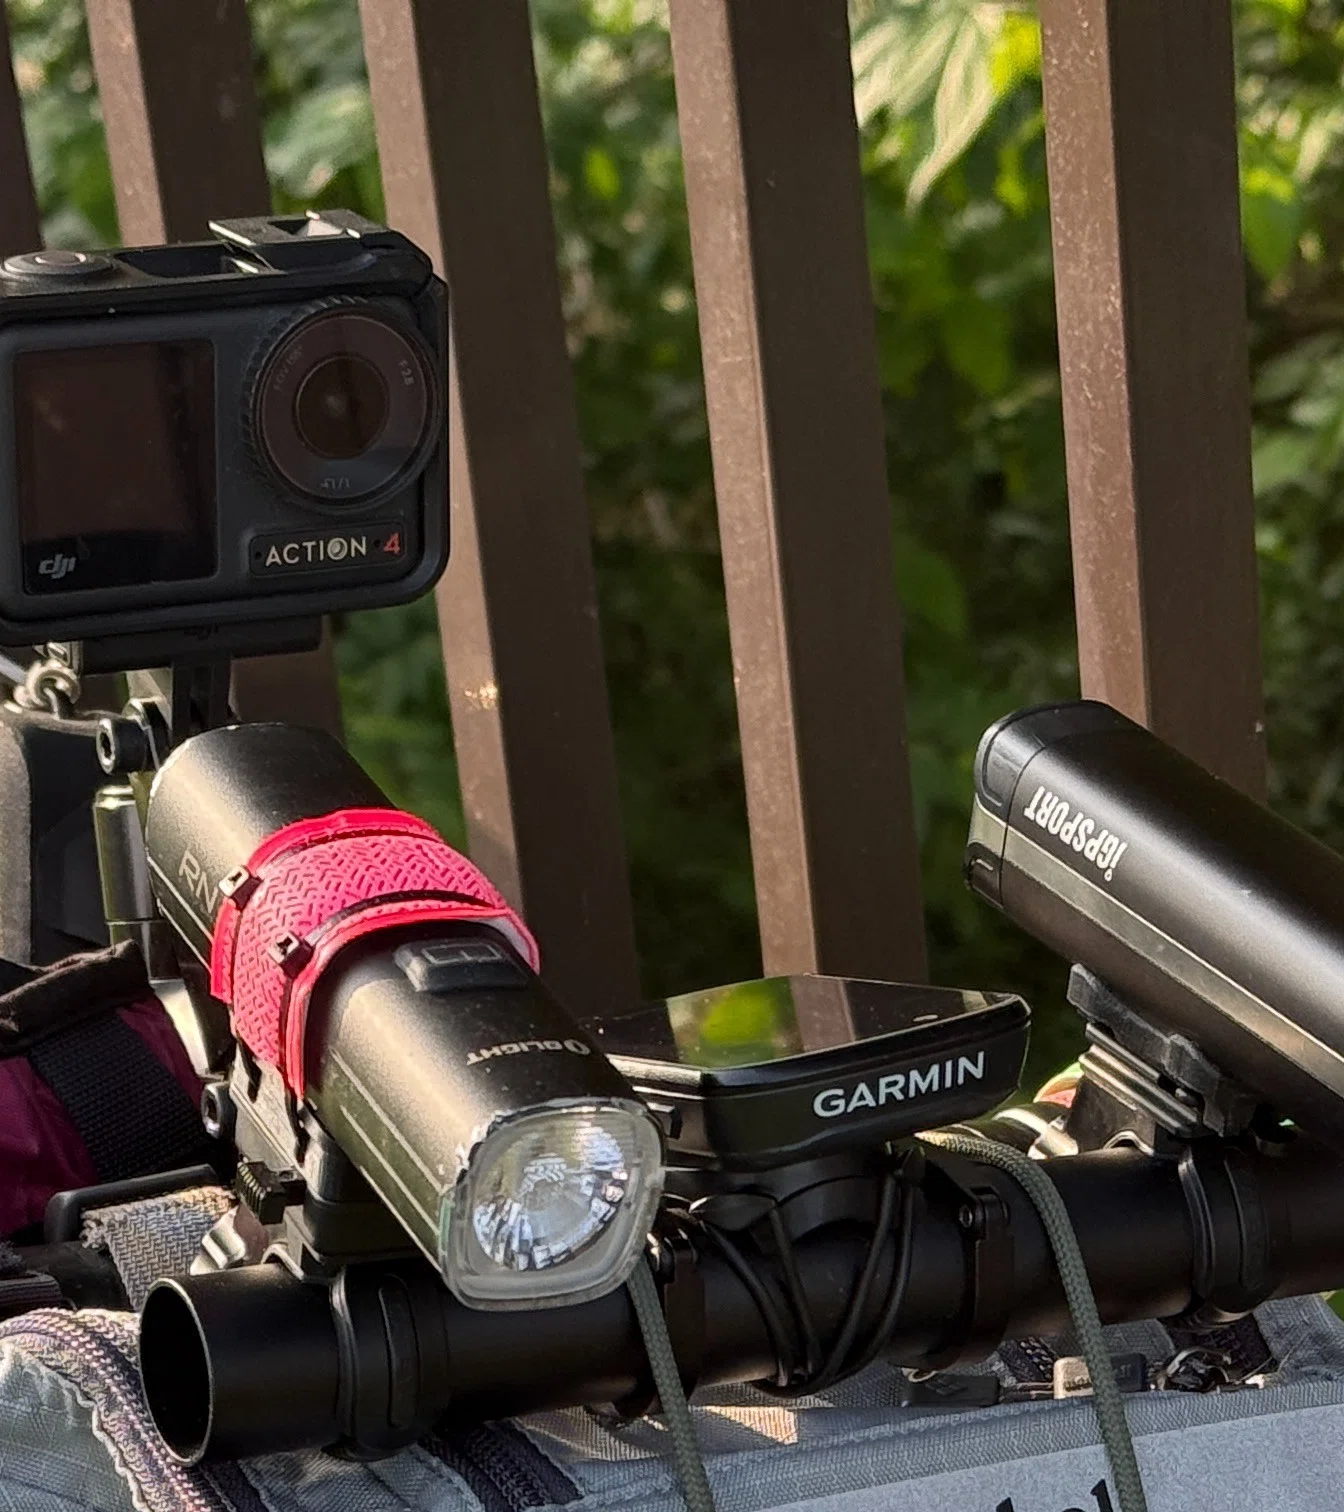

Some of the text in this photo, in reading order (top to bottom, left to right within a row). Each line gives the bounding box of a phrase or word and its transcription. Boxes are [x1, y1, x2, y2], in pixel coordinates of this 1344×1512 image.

[38, 553, 76, 579] dji
[265, 532, 400, 567] ACTION 4
[1023, 785, 1128, 882] iGPSPORT
[813, 1051, 985, 1118] GARMIN
